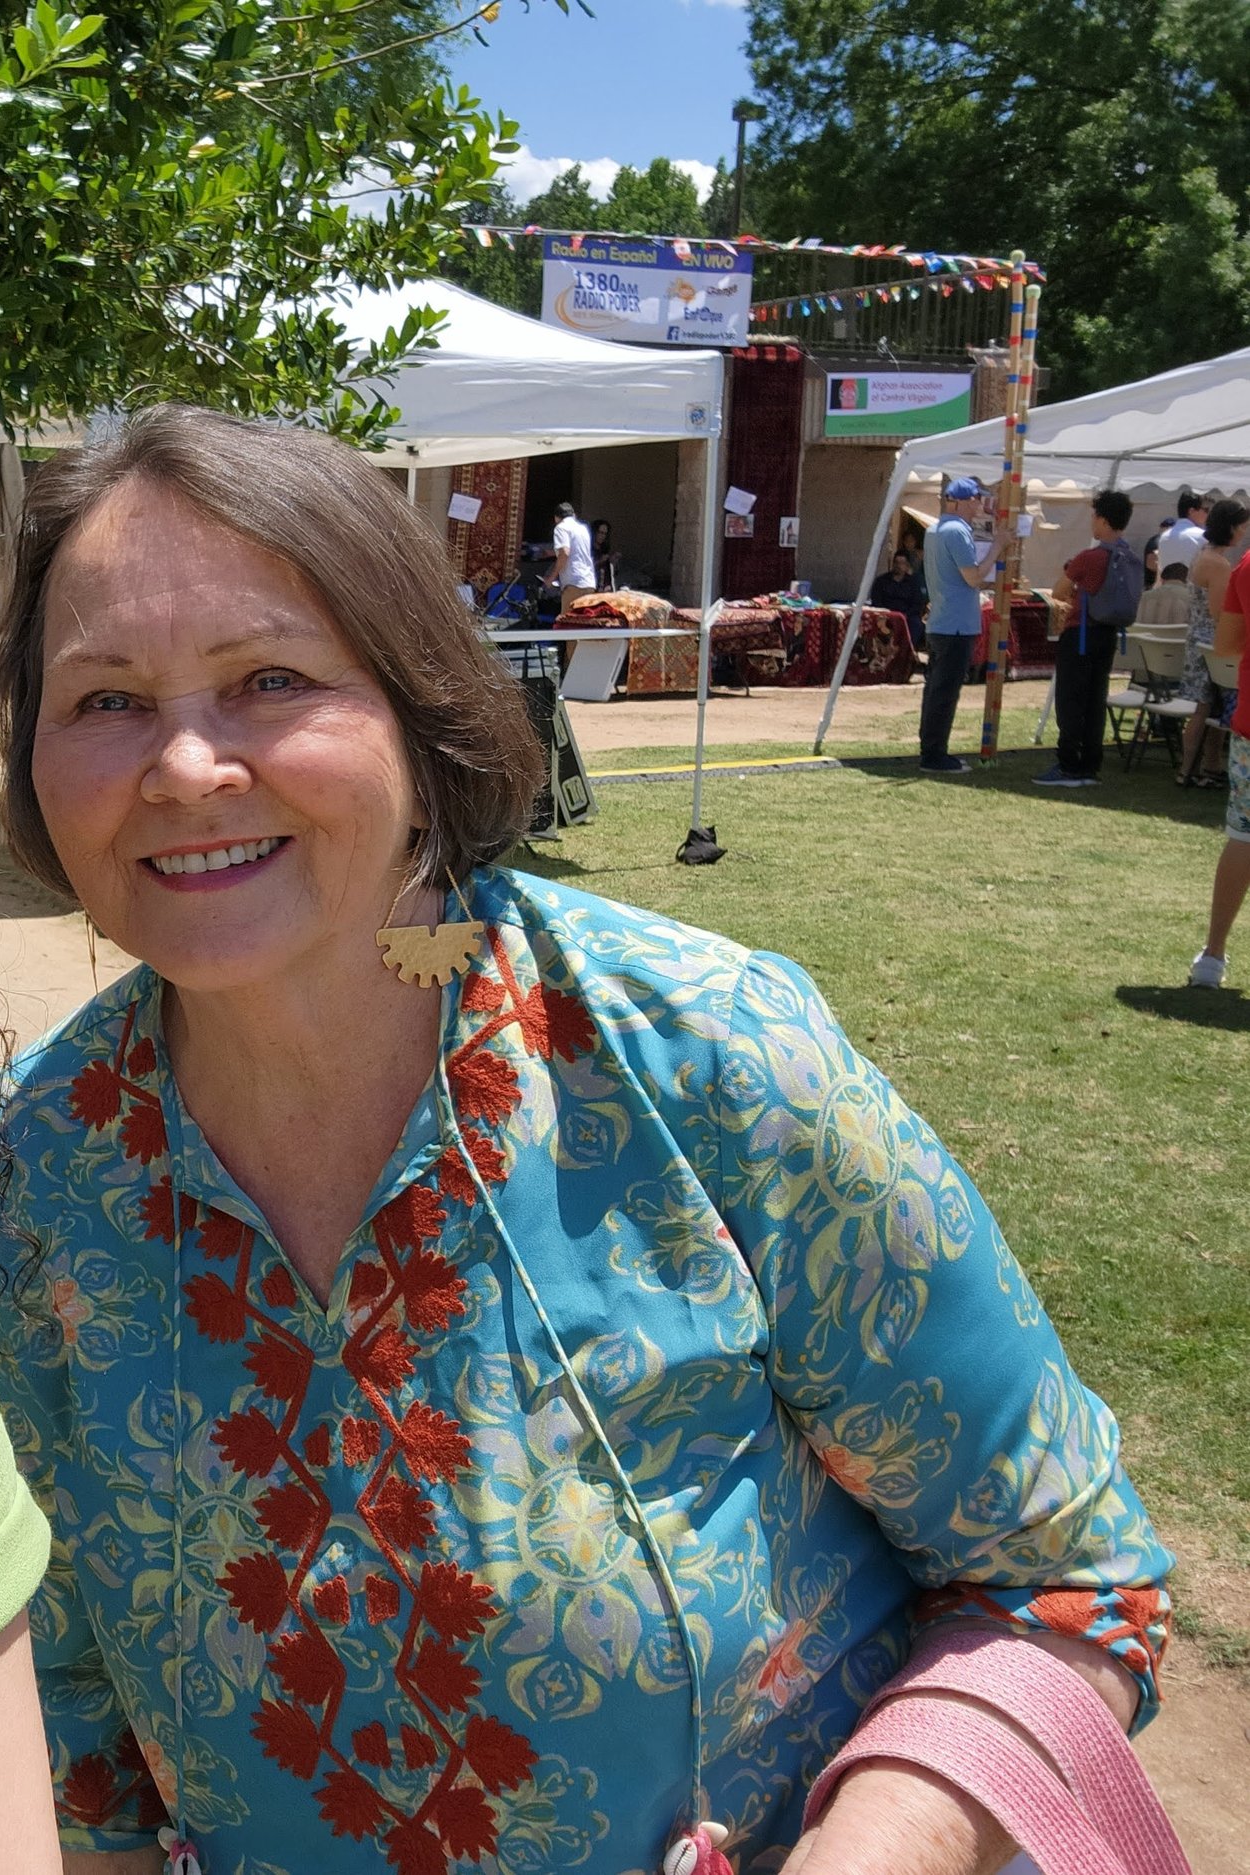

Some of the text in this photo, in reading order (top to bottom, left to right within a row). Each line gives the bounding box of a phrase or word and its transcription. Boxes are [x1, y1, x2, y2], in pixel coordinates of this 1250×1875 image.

[551, 241, 658, 264] Radio en Español
[703, 254, 735, 270] VIVO
[609, 293, 641, 313] PODER
[900, 380, 943, 391] Association
